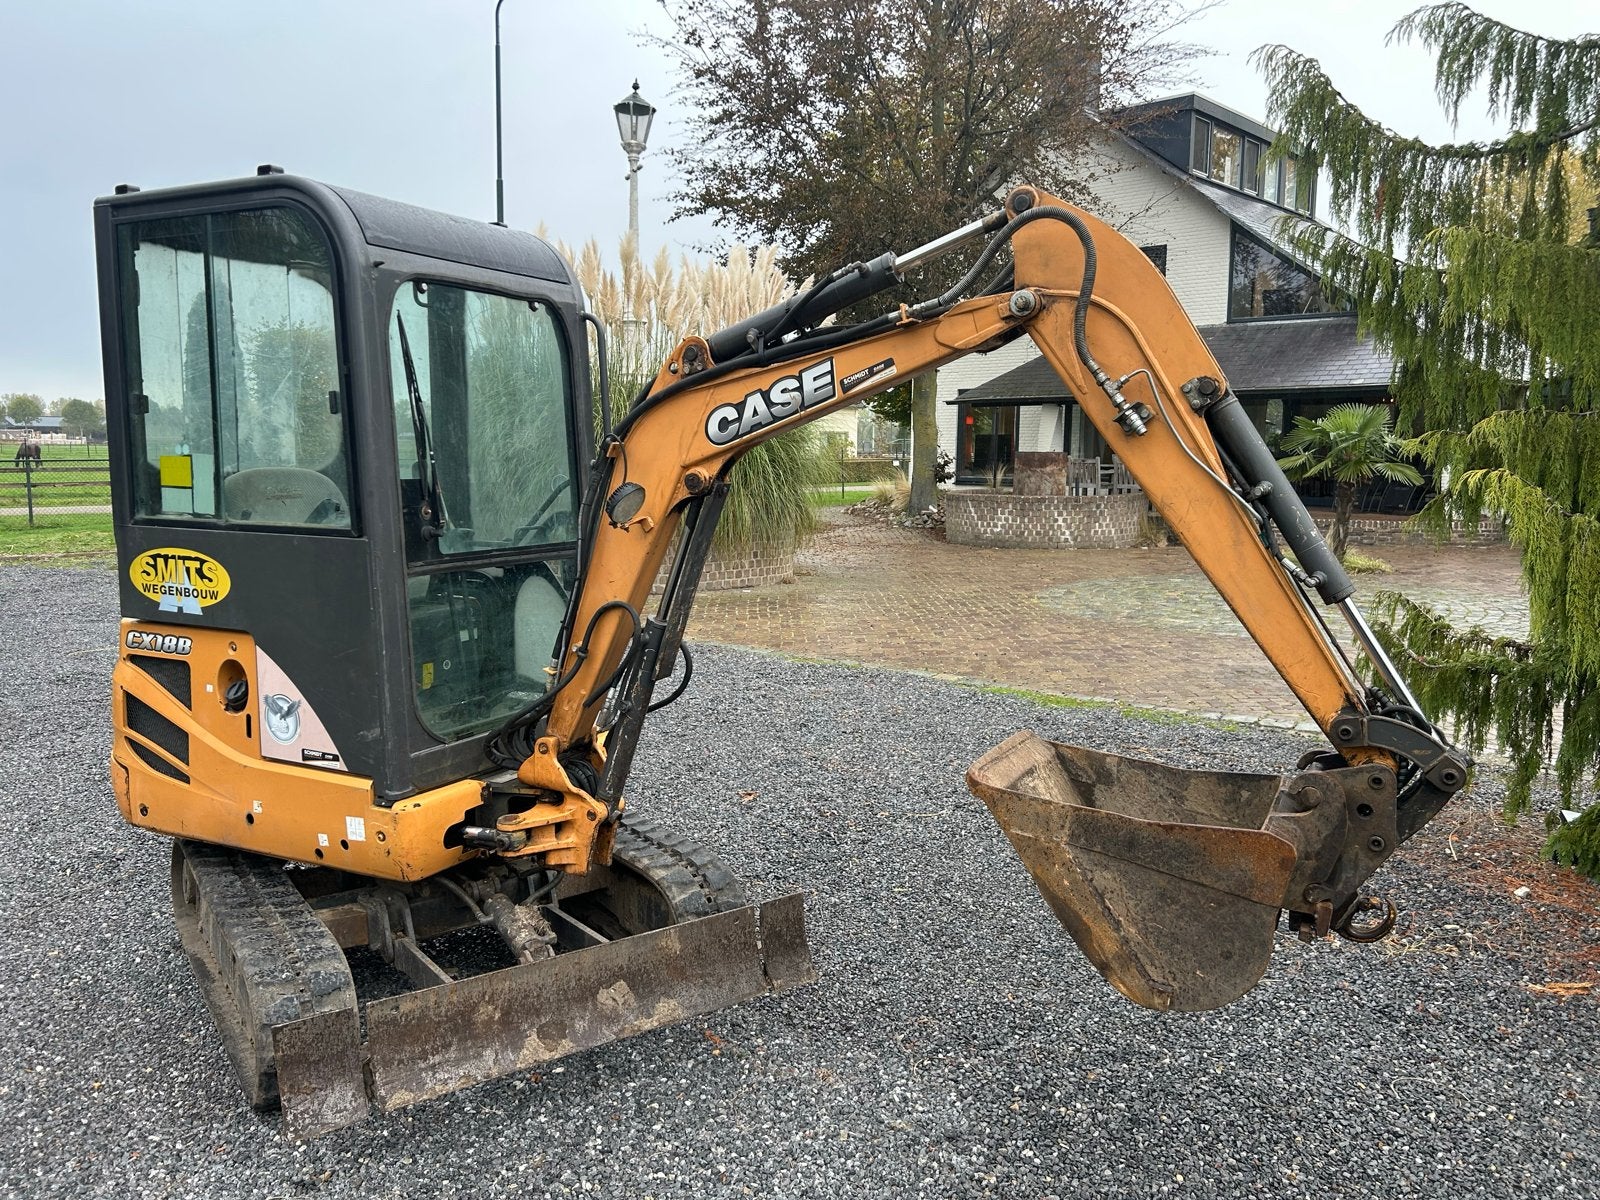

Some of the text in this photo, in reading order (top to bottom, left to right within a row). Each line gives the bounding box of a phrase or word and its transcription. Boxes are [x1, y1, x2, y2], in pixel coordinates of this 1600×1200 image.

[843, 368, 870, 385] SCHMIDT
[706, 358, 835, 443] CASE
[140, 554, 219, 588] SMITS
[141, 582, 219, 600] WEGENBOUW
[126, 630, 192, 655] CX18B
